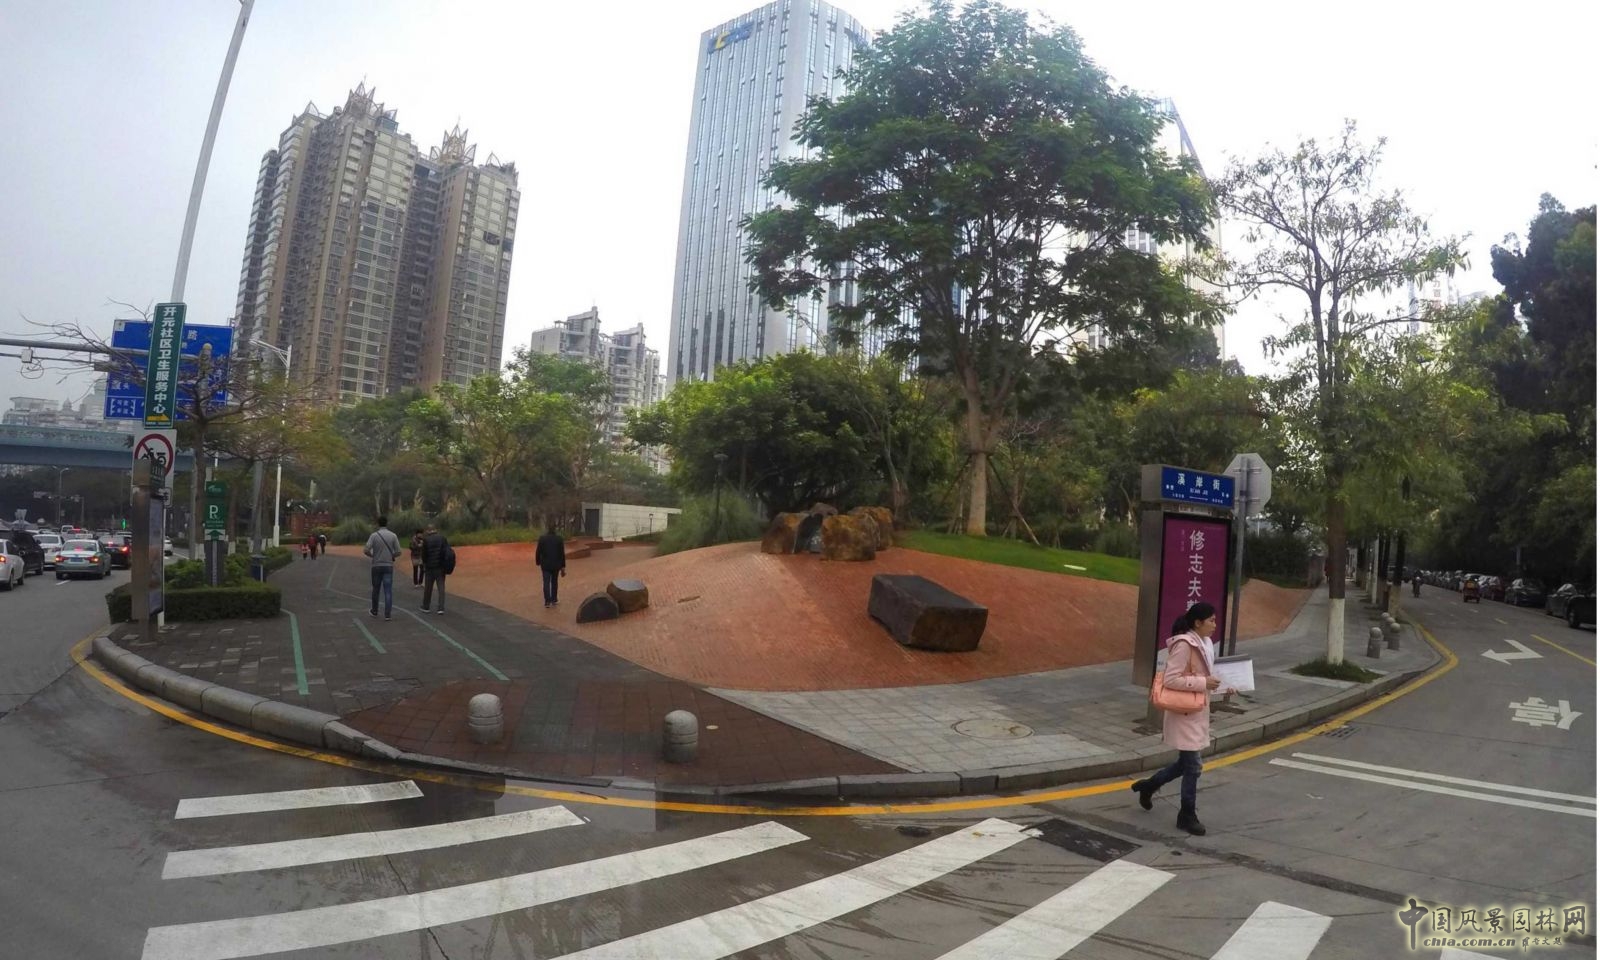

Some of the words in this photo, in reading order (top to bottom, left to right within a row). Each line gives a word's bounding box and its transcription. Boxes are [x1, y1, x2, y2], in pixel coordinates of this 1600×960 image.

[153, 306, 177, 414] 开元社区卫生服务中心
[1177, 473, 1220, 490] 溪岸街
